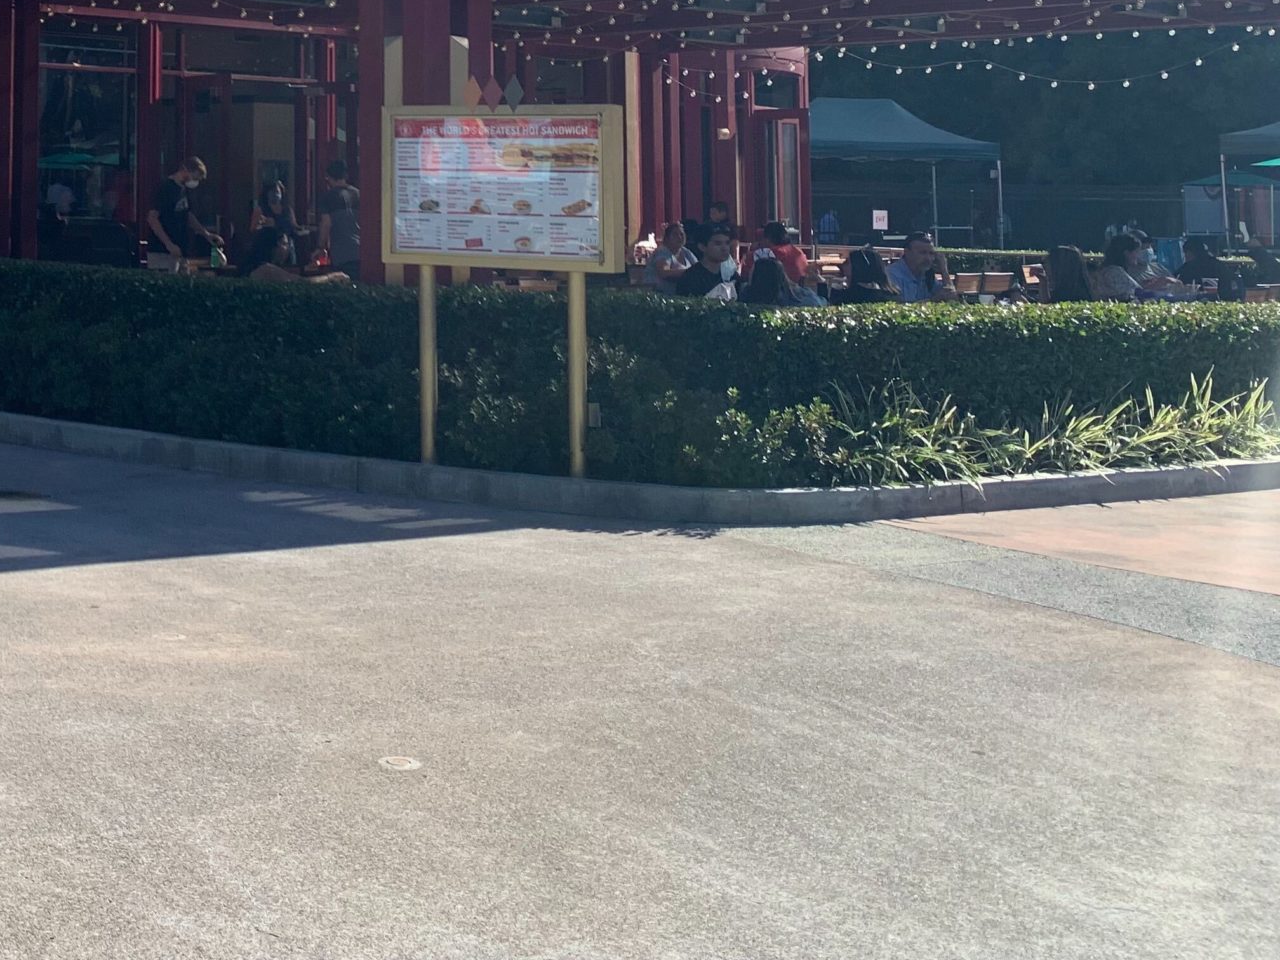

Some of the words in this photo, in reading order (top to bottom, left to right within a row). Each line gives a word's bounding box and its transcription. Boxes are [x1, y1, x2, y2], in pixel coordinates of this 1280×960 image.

[422, 125, 437, 135] THE
[523, 125, 539, 135] HOT
[541, 125, 588, 135] SANDWICH
